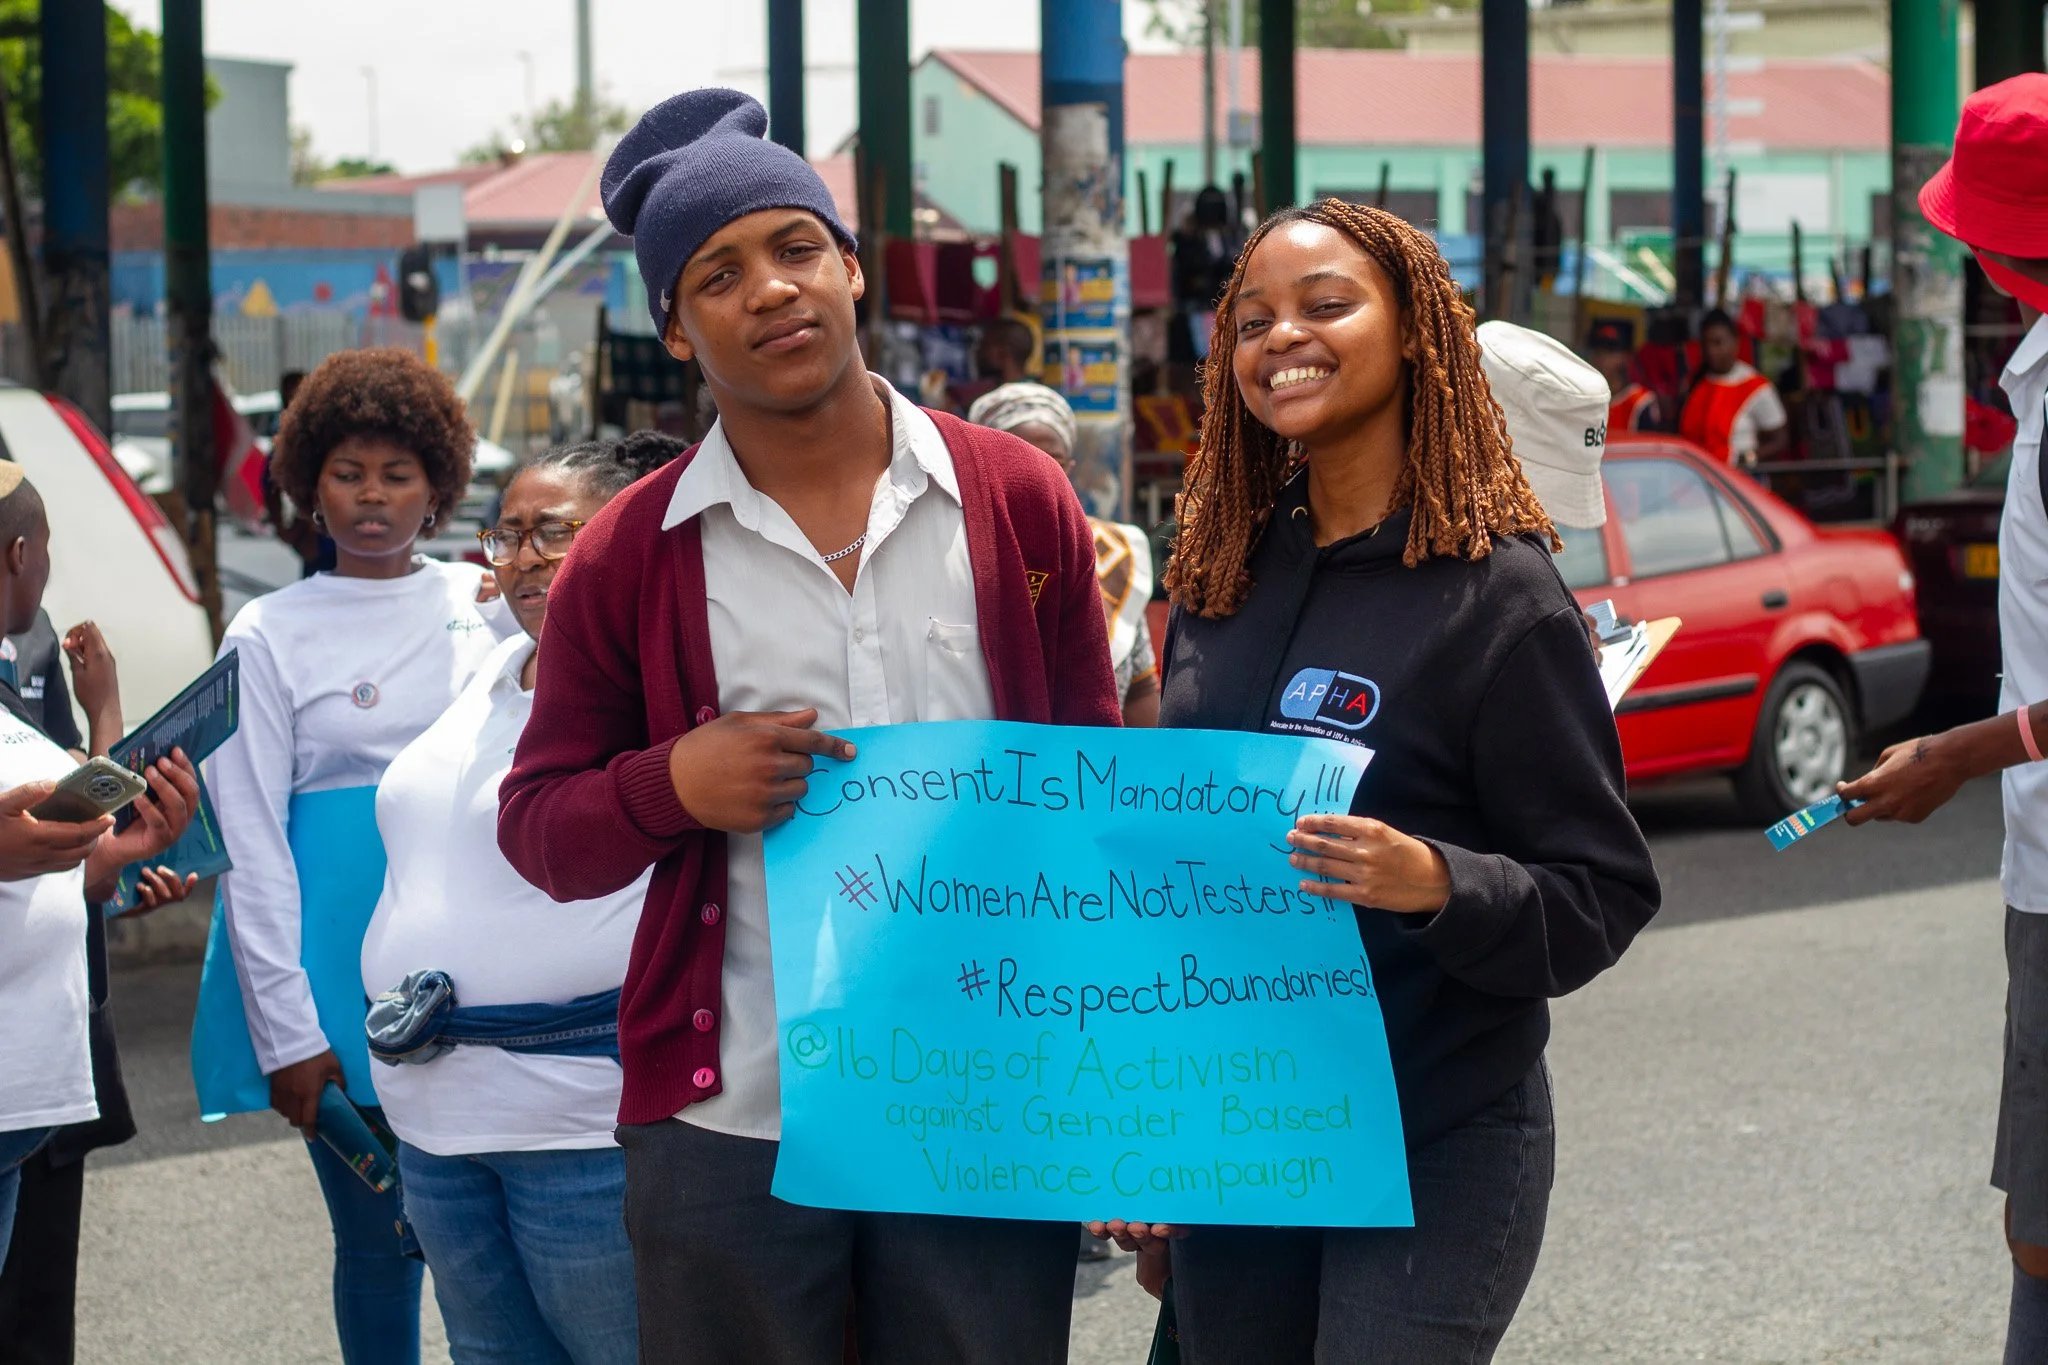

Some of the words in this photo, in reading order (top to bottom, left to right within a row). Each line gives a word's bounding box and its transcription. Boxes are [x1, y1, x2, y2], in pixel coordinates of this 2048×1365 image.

[1287, 681, 1367, 716] APHA
[957, 953, 1375, 1032] #RespectBoundaries!
[891, 1027, 996, 1105] Days
[1005, 1030, 1057, 1087] of
[1067, 1037, 1297, 1099] Activism
[885, 1095, 1003, 1141] against
[1022, 1094, 1185, 1140] Gender
[1221, 1094, 1352, 1135] Based
[922, 1147, 1101, 1195] Violence
[1111, 1151, 1333, 1206] Campaign
